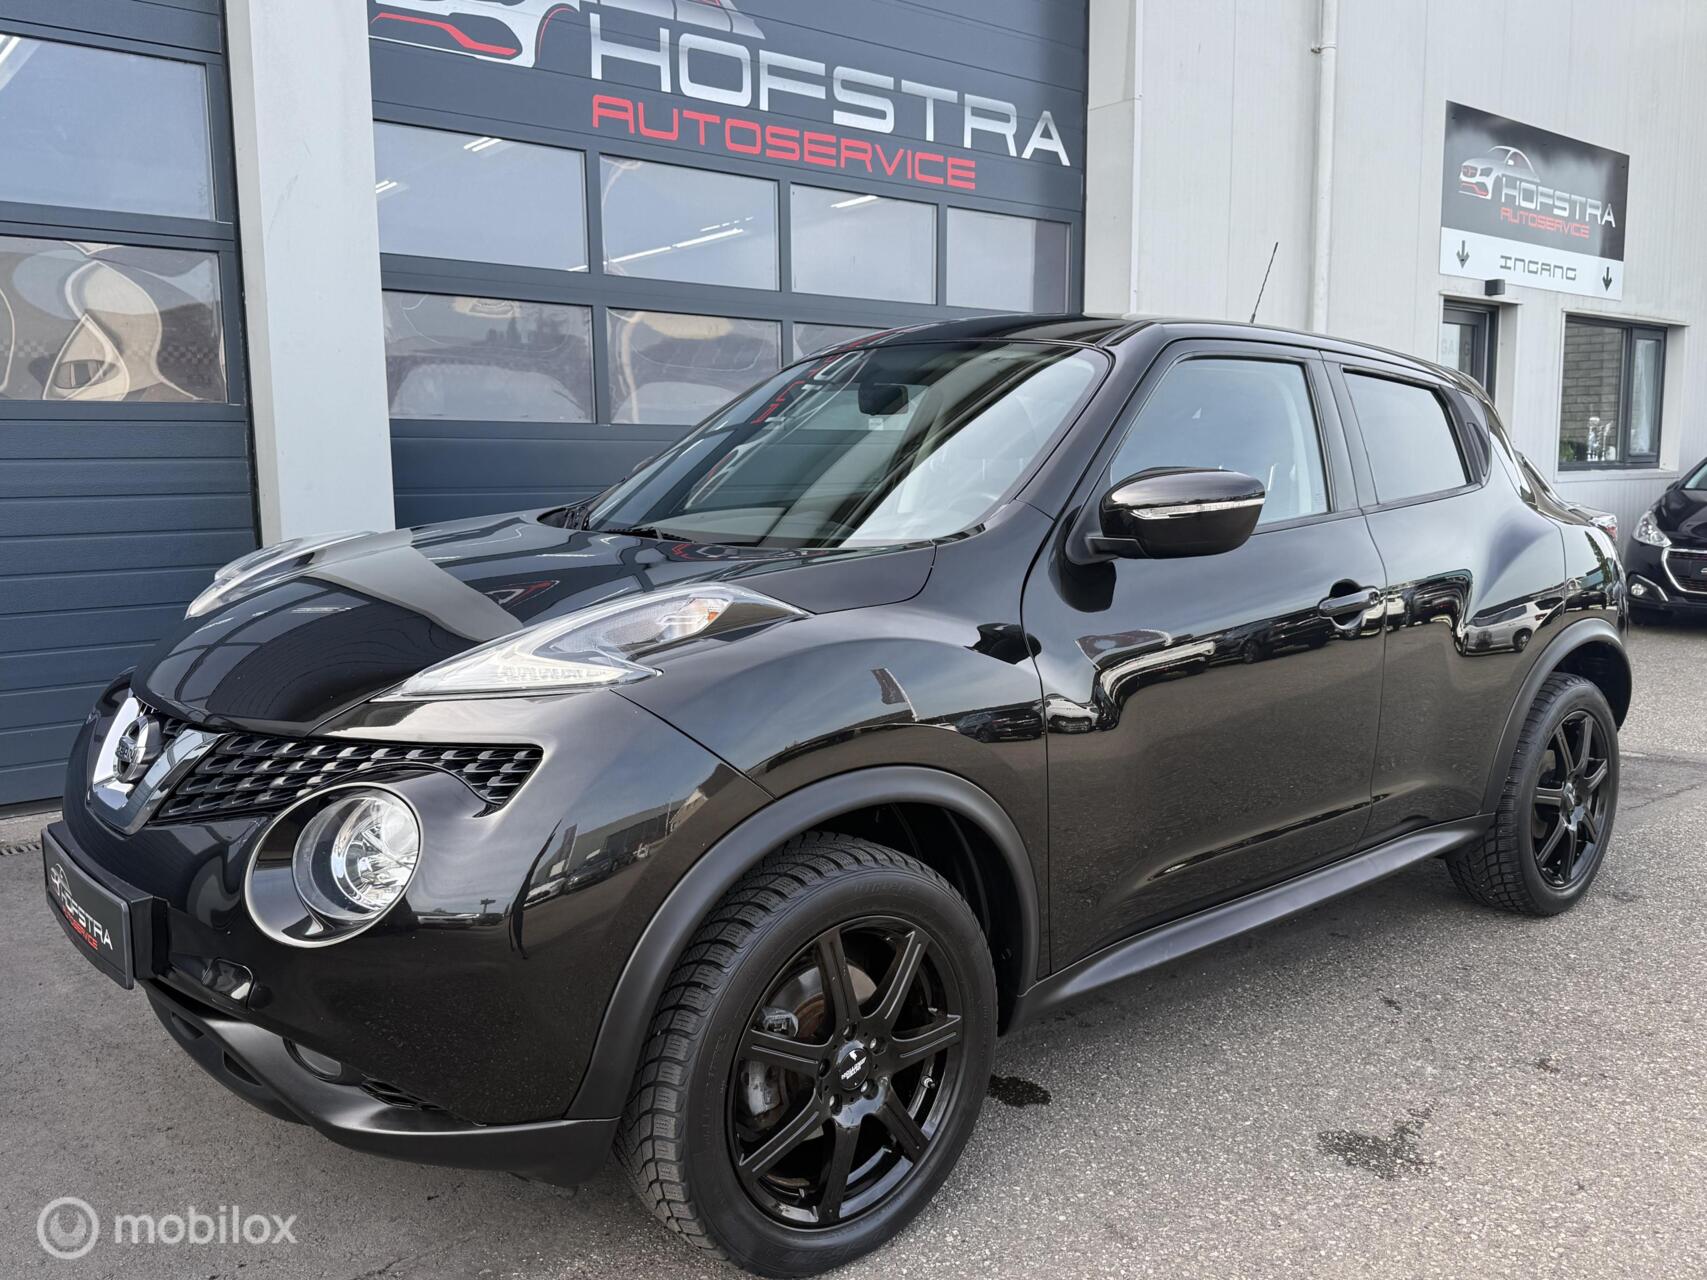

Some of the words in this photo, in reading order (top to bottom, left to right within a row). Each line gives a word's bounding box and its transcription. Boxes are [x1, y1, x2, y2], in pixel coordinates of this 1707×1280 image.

[590, 12, 1071, 167] HOFSTRA
[592, 94, 977, 190] AUTOSERVICE
[1500, 206, 1591, 240] AUTOSERVICE
[1501, 177, 1616, 228] HOFSTRA
[1499, 253, 1577, 281] INGANG
[60, 885, 114, 951] HOFSTRA
